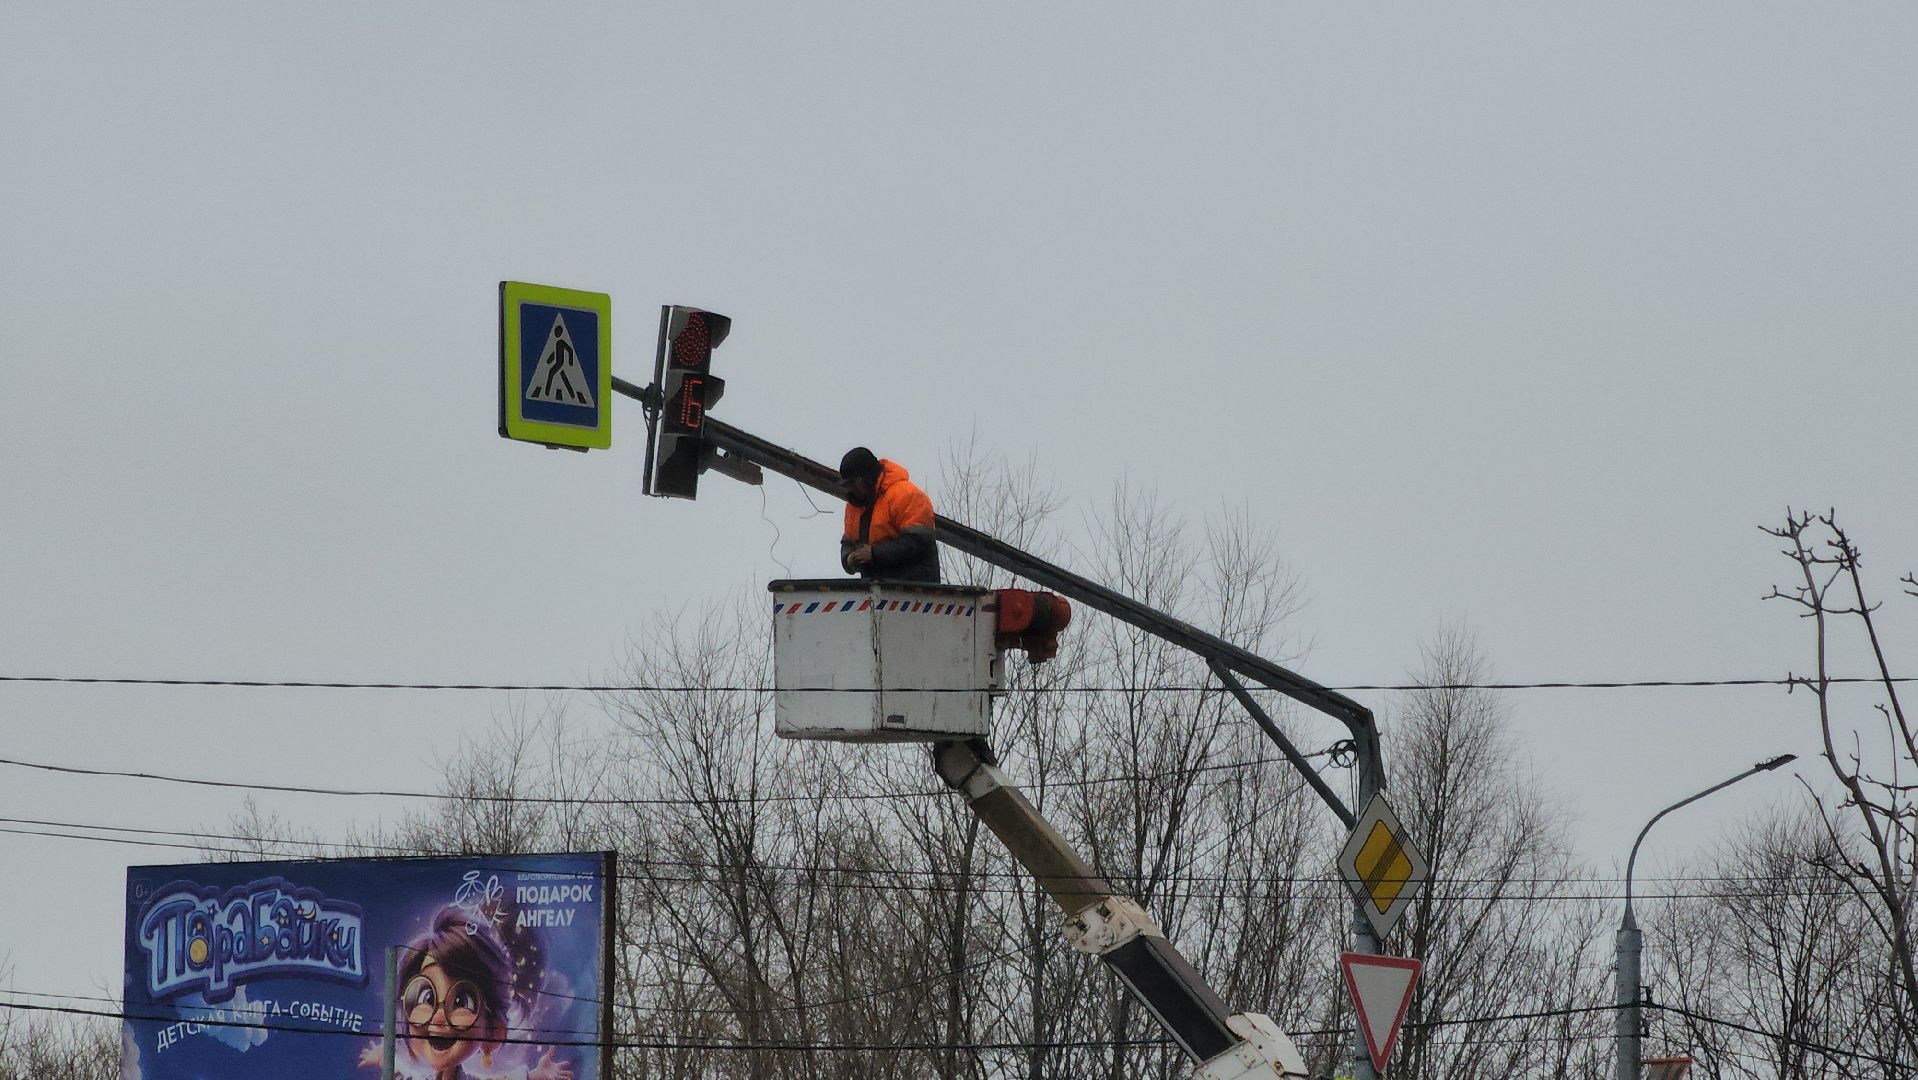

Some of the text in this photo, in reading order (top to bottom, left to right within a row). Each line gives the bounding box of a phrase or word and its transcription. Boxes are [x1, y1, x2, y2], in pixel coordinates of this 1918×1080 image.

[135, 884, 149, 899] 0+
[516, 884, 593, 904] ПОДАРОК
[515, 908, 576, 928] АНГЕЛУ
[156, 999, 363, 1053] ДЕТСКАЯ КНИГА-СОБЫТИЕ
